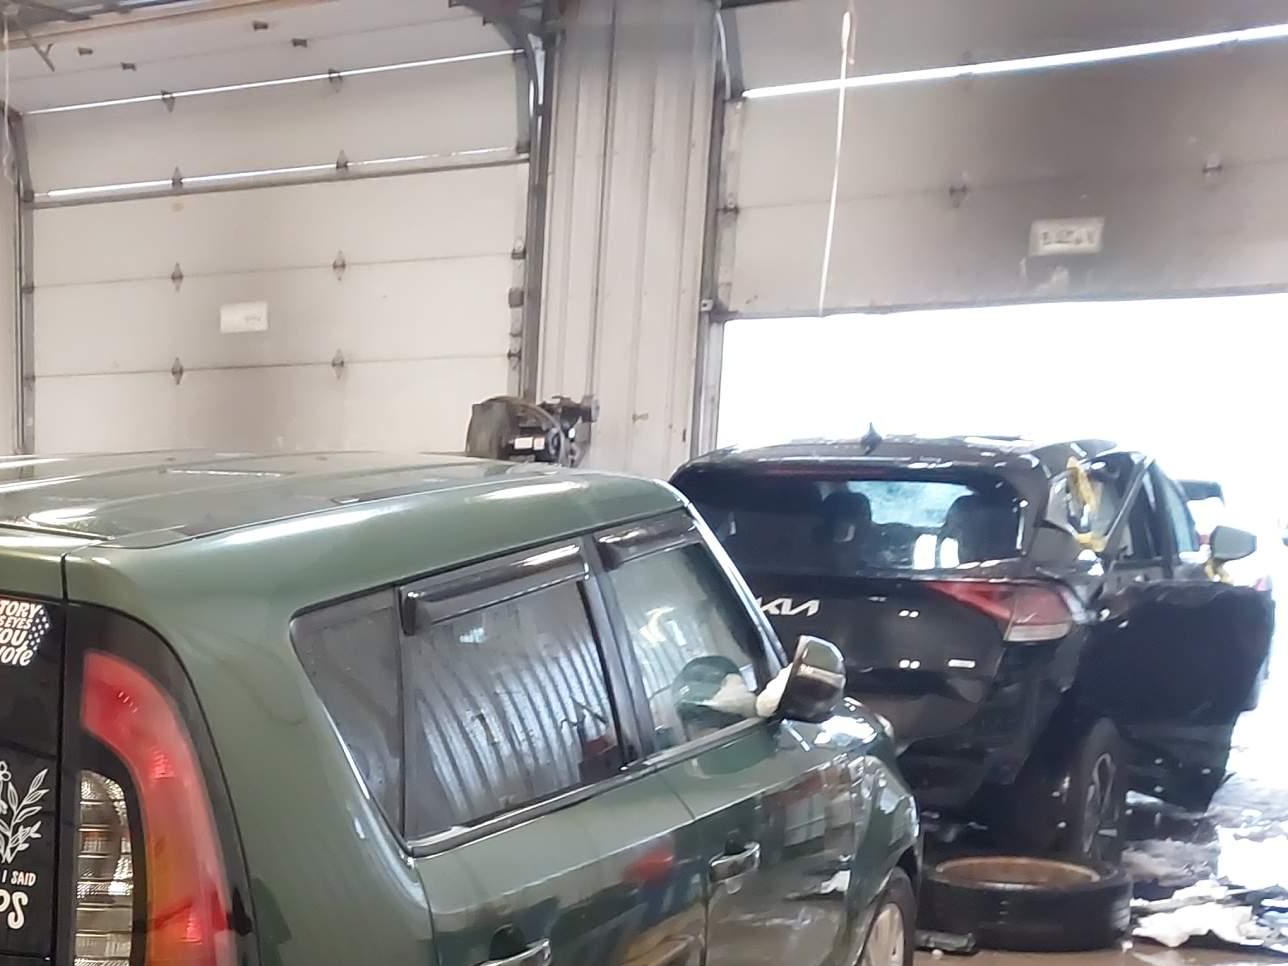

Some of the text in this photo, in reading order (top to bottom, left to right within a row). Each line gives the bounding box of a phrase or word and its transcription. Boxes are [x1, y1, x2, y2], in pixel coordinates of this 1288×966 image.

[4, 616, 33, 630] EYES
[1, 869, 8, 883] I
[11, 871, 37, 886] SAID
